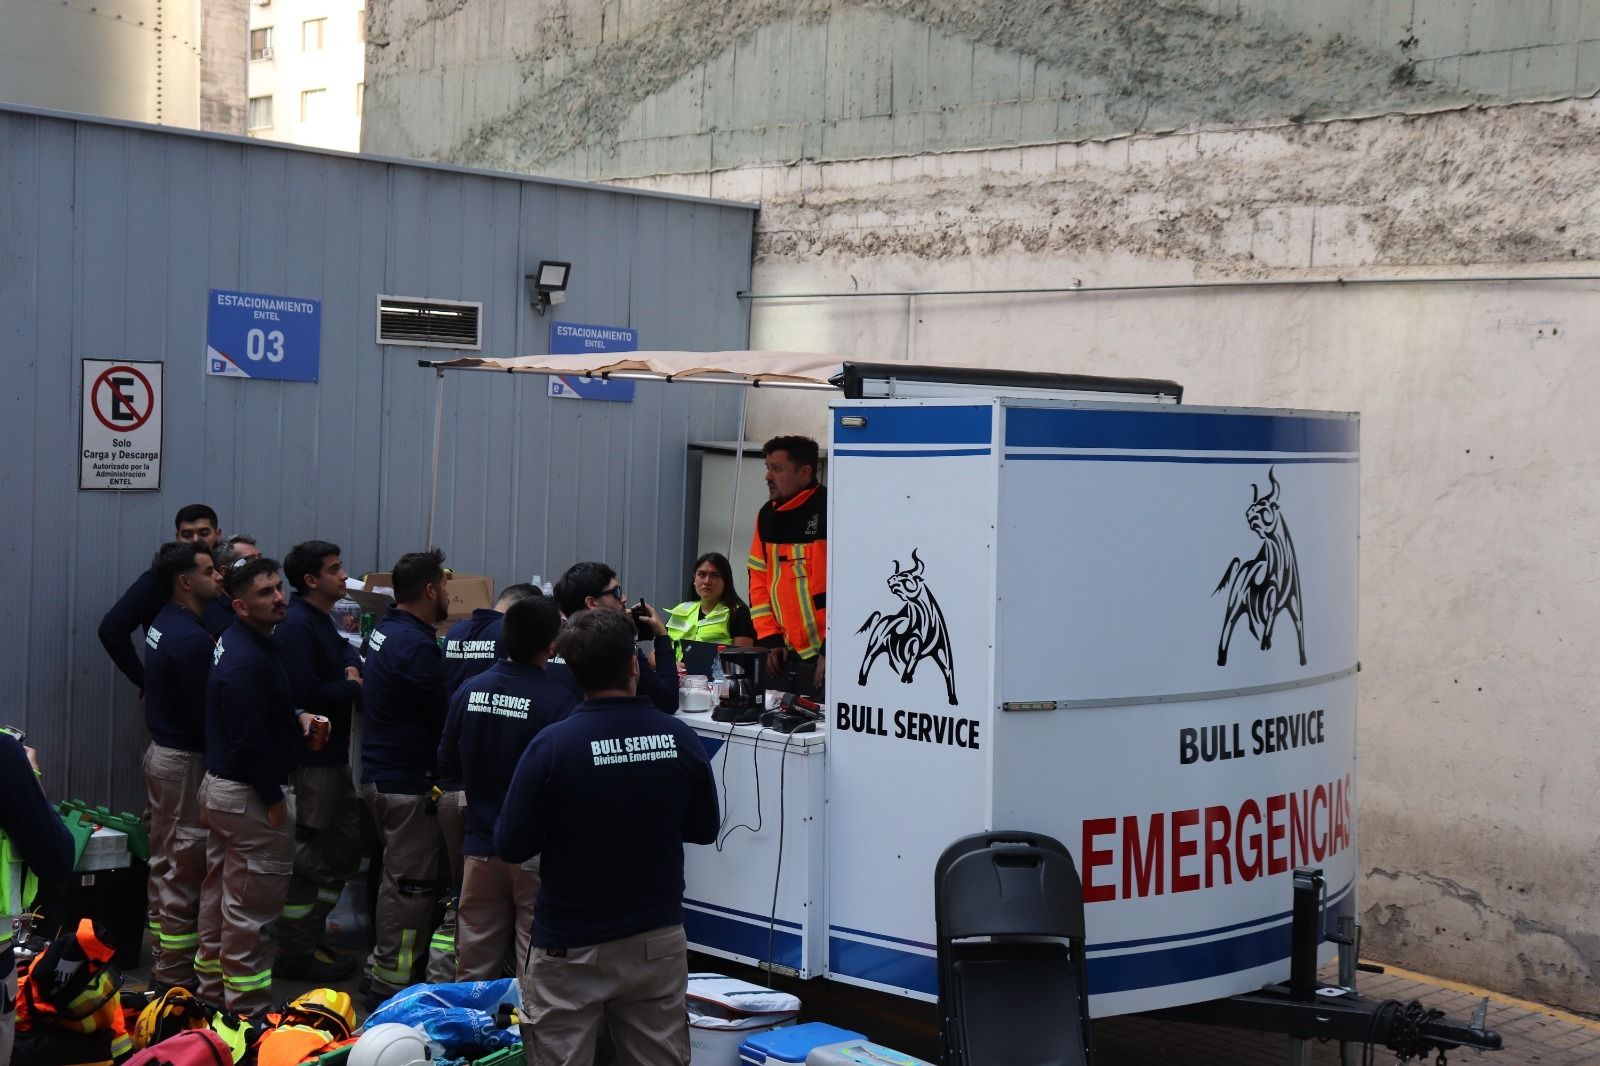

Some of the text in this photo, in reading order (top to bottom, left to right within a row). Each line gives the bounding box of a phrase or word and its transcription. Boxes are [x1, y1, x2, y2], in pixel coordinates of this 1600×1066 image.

[217, 294, 314, 314] ESTACIONAMIENTO
[253, 310, 280, 321] ENTEL
[557, 326, 632, 341] ESTACIONAMIENTO
[246, 328, 285, 363] 03
[585, 340, 605, 348] ENTEL
[111, 377, 135, 420] E
[112, 438, 132, 448] Solo
[83, 449, 159, 462] Carga y Descarga
[92, 462, 150, 472] Autorizado por la
[109, 478, 132, 486] ENTEL
[462, 640, 496, 652] SERVICE
[468, 691, 490, 705] BULL
[836, 702, 980, 749] BULL SERVICE
[1180, 709, 1325, 765] BULL SERVICE
[590, 734, 677, 756] BULL SERVICE
[593, 748, 678, 766] Division Emergencia
[1081, 772, 1351, 904] EMERGENCIAS
